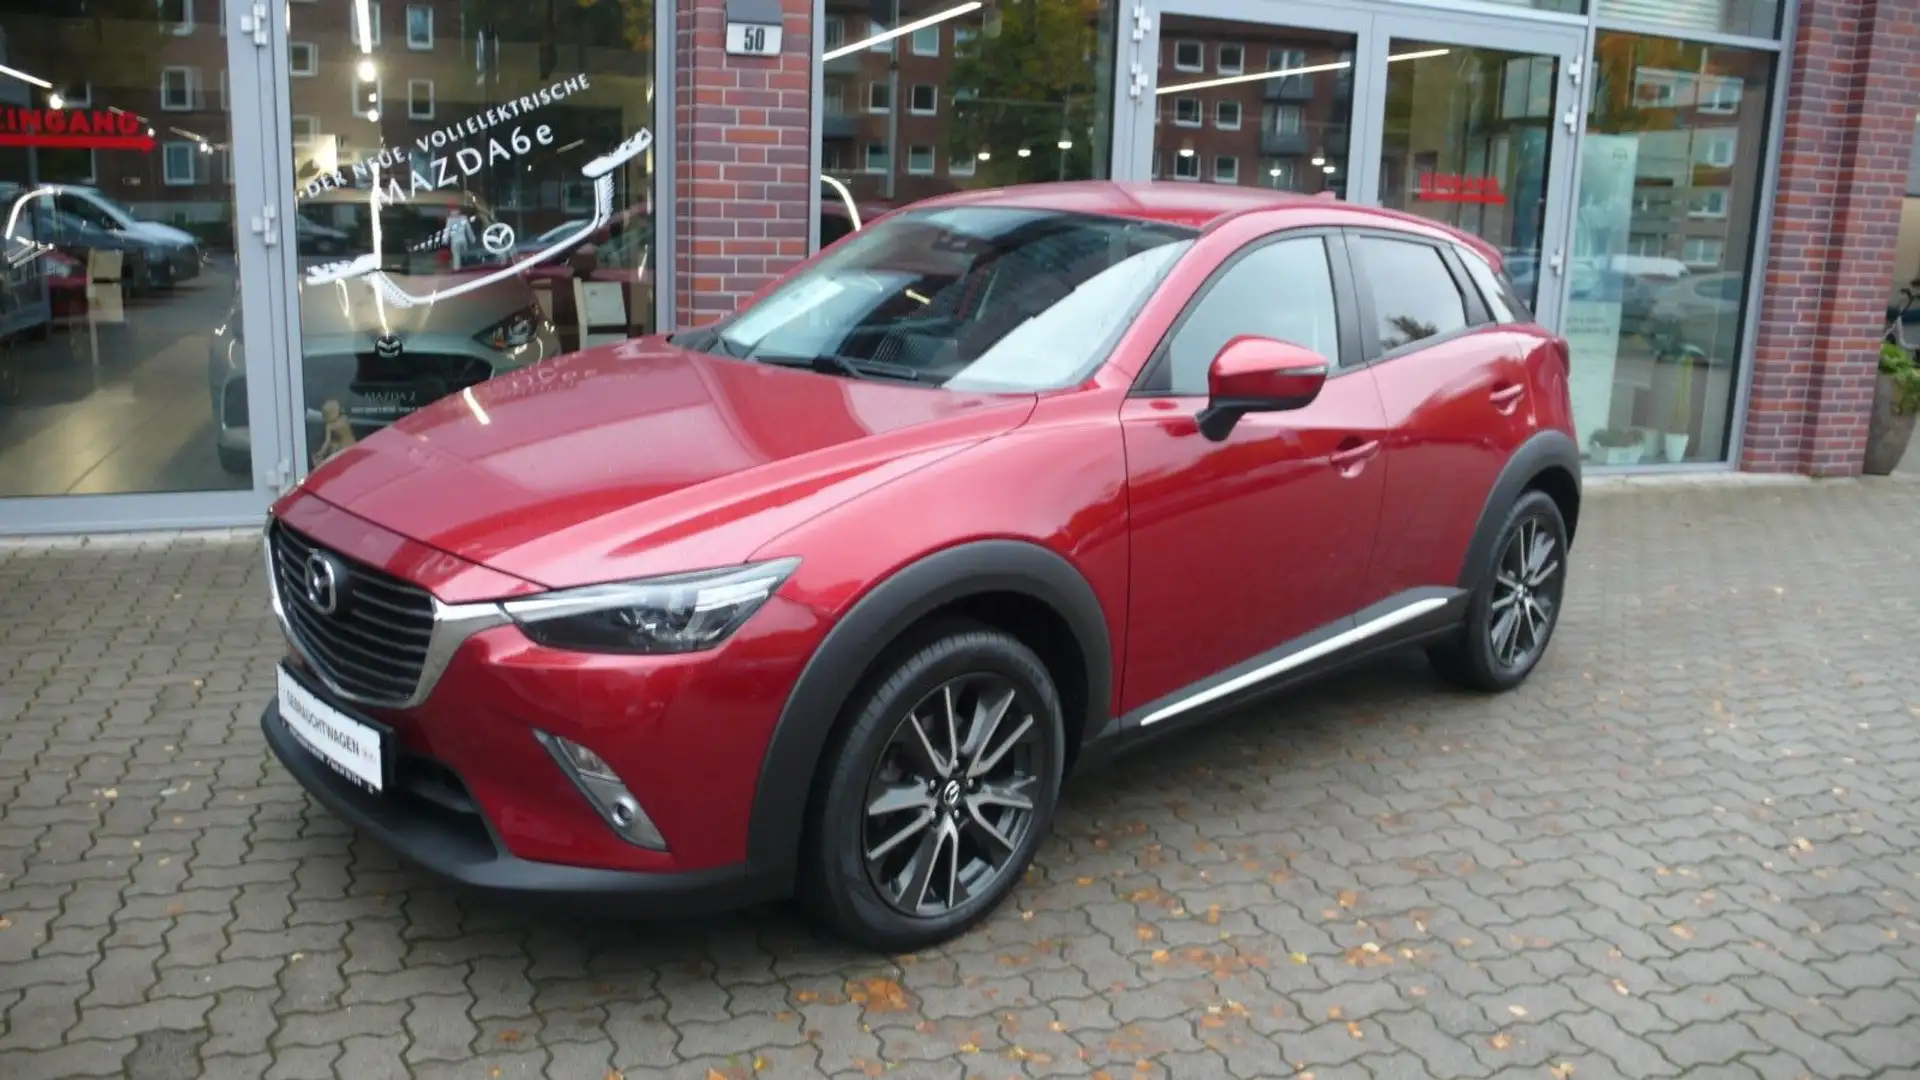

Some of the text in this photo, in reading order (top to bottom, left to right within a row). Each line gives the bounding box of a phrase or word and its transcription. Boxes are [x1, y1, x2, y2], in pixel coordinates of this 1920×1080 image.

[744, 27, 765, 51] 50
[0, 104, 138, 135] INGANG
[306, 171, 347, 198] DER
[416, 73, 590, 152] VOLLELEKTRISCHE
[377, 124, 553, 211] MAZDA6e
[286, 689, 360, 756] GEBRAUCHTWAGEN
